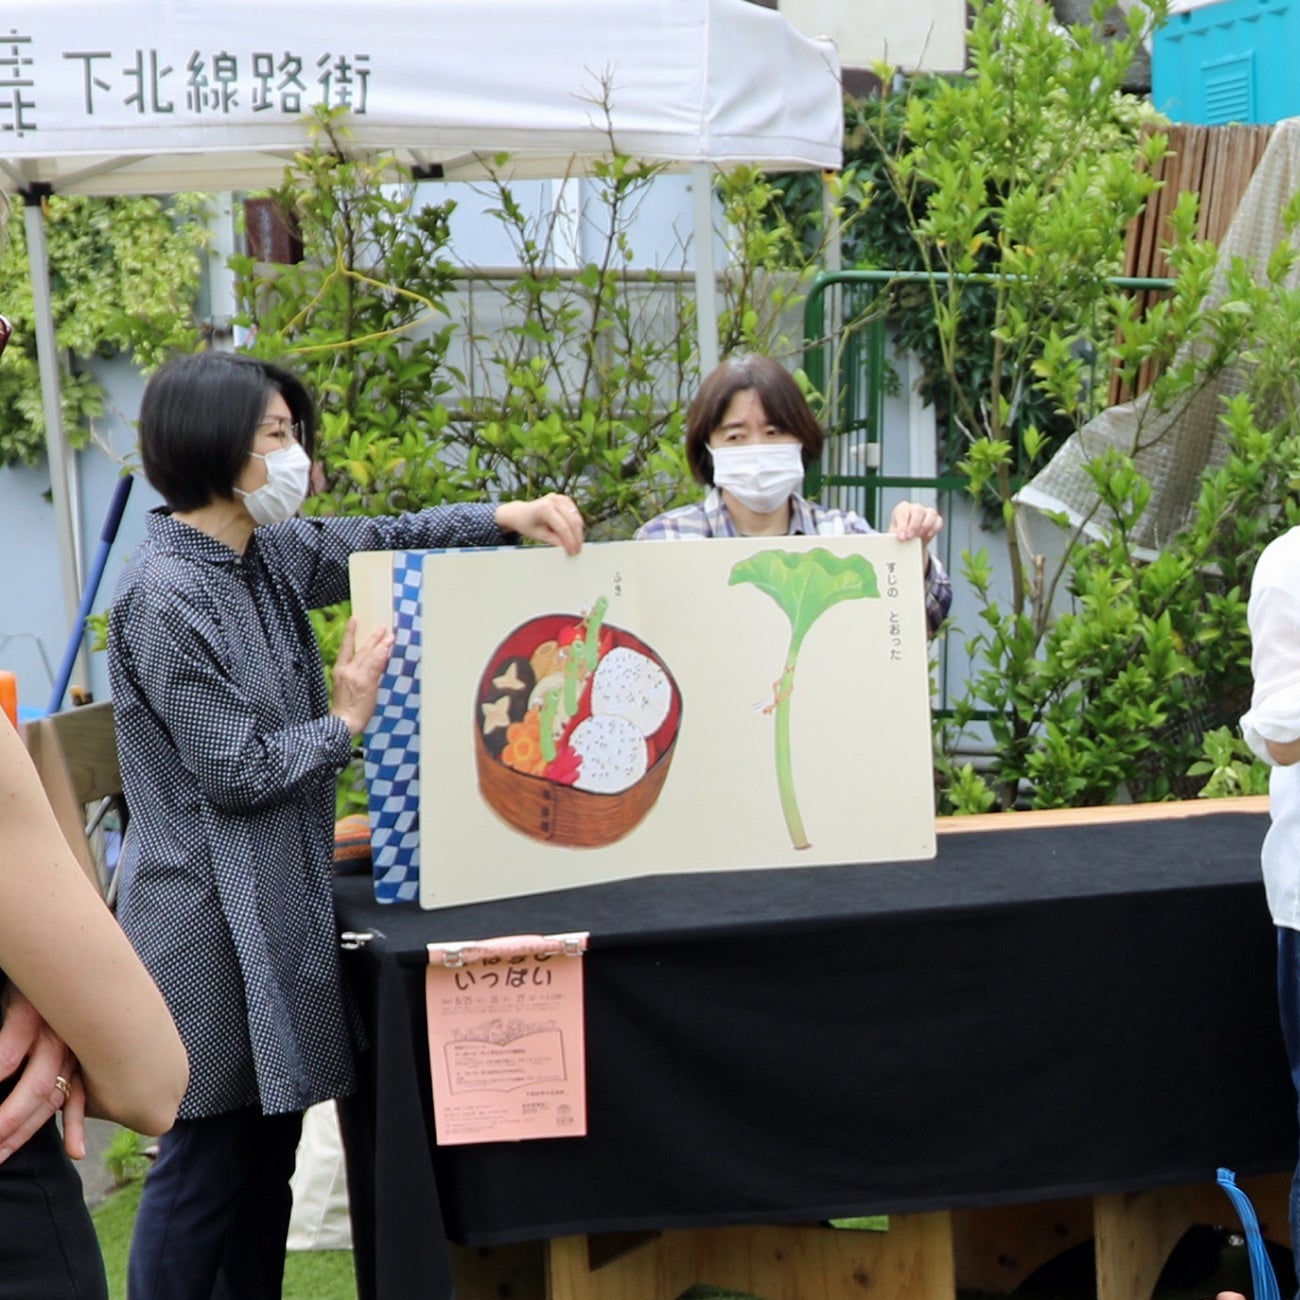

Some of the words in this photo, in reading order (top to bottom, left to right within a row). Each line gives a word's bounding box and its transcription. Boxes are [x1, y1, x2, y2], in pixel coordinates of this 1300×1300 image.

[62, 49, 370, 115] 下北線路街
[455, 967, 551, 990] いっぱい
